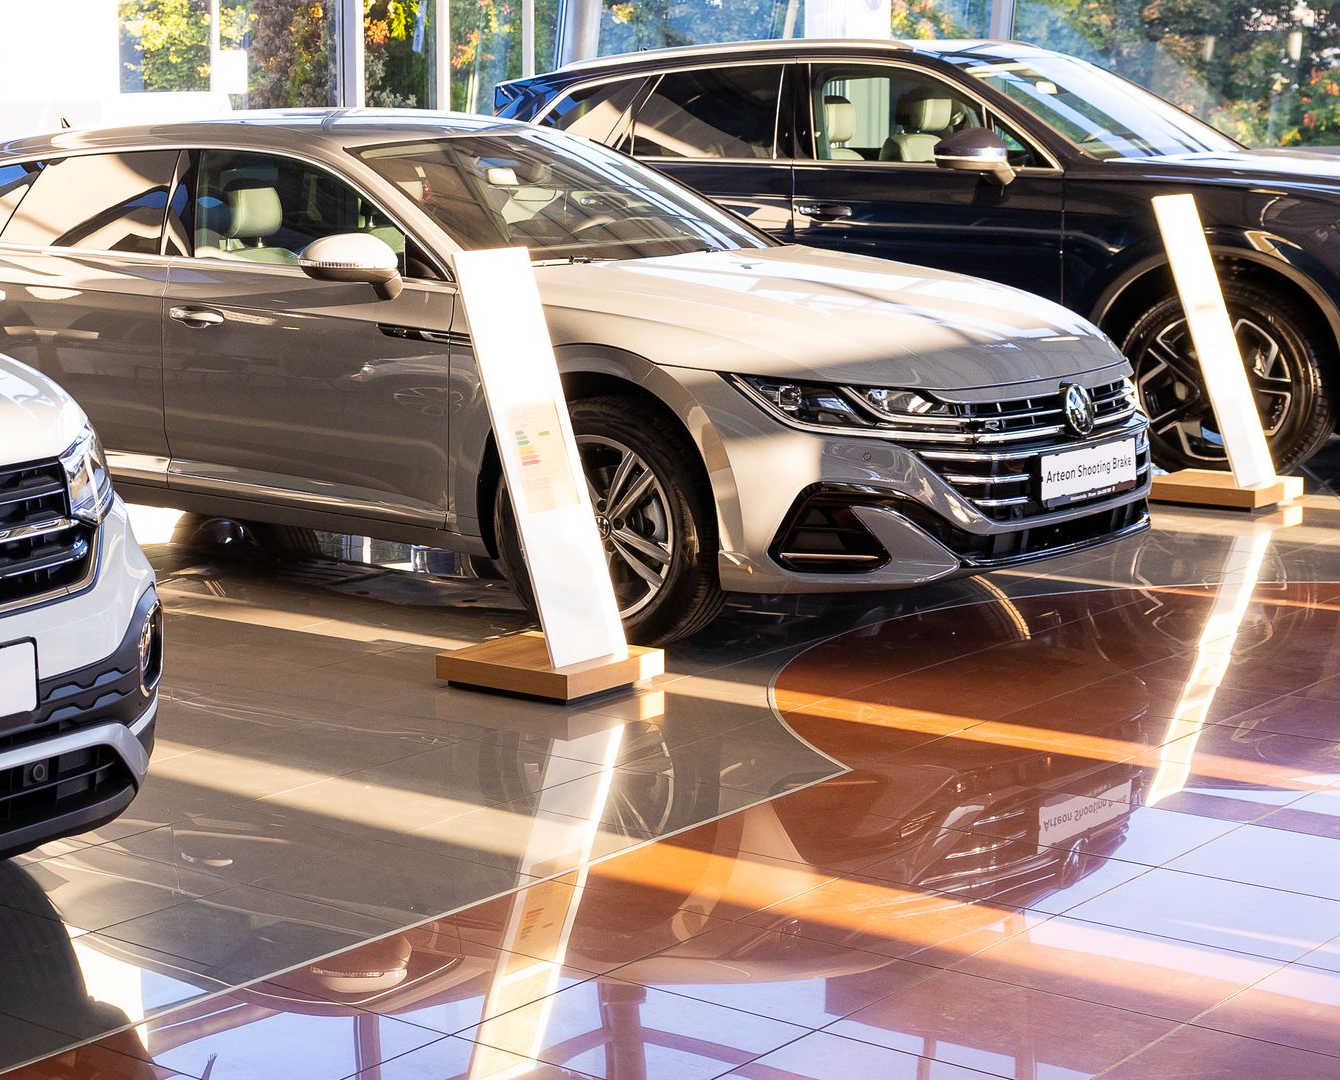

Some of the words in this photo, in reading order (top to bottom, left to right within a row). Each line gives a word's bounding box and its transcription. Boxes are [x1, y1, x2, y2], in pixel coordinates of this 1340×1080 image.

[1046, 469, 1075, 483] Arteon
[1078, 460, 1110, 477] Shooting
[1113, 455, 1131, 469] Brake
